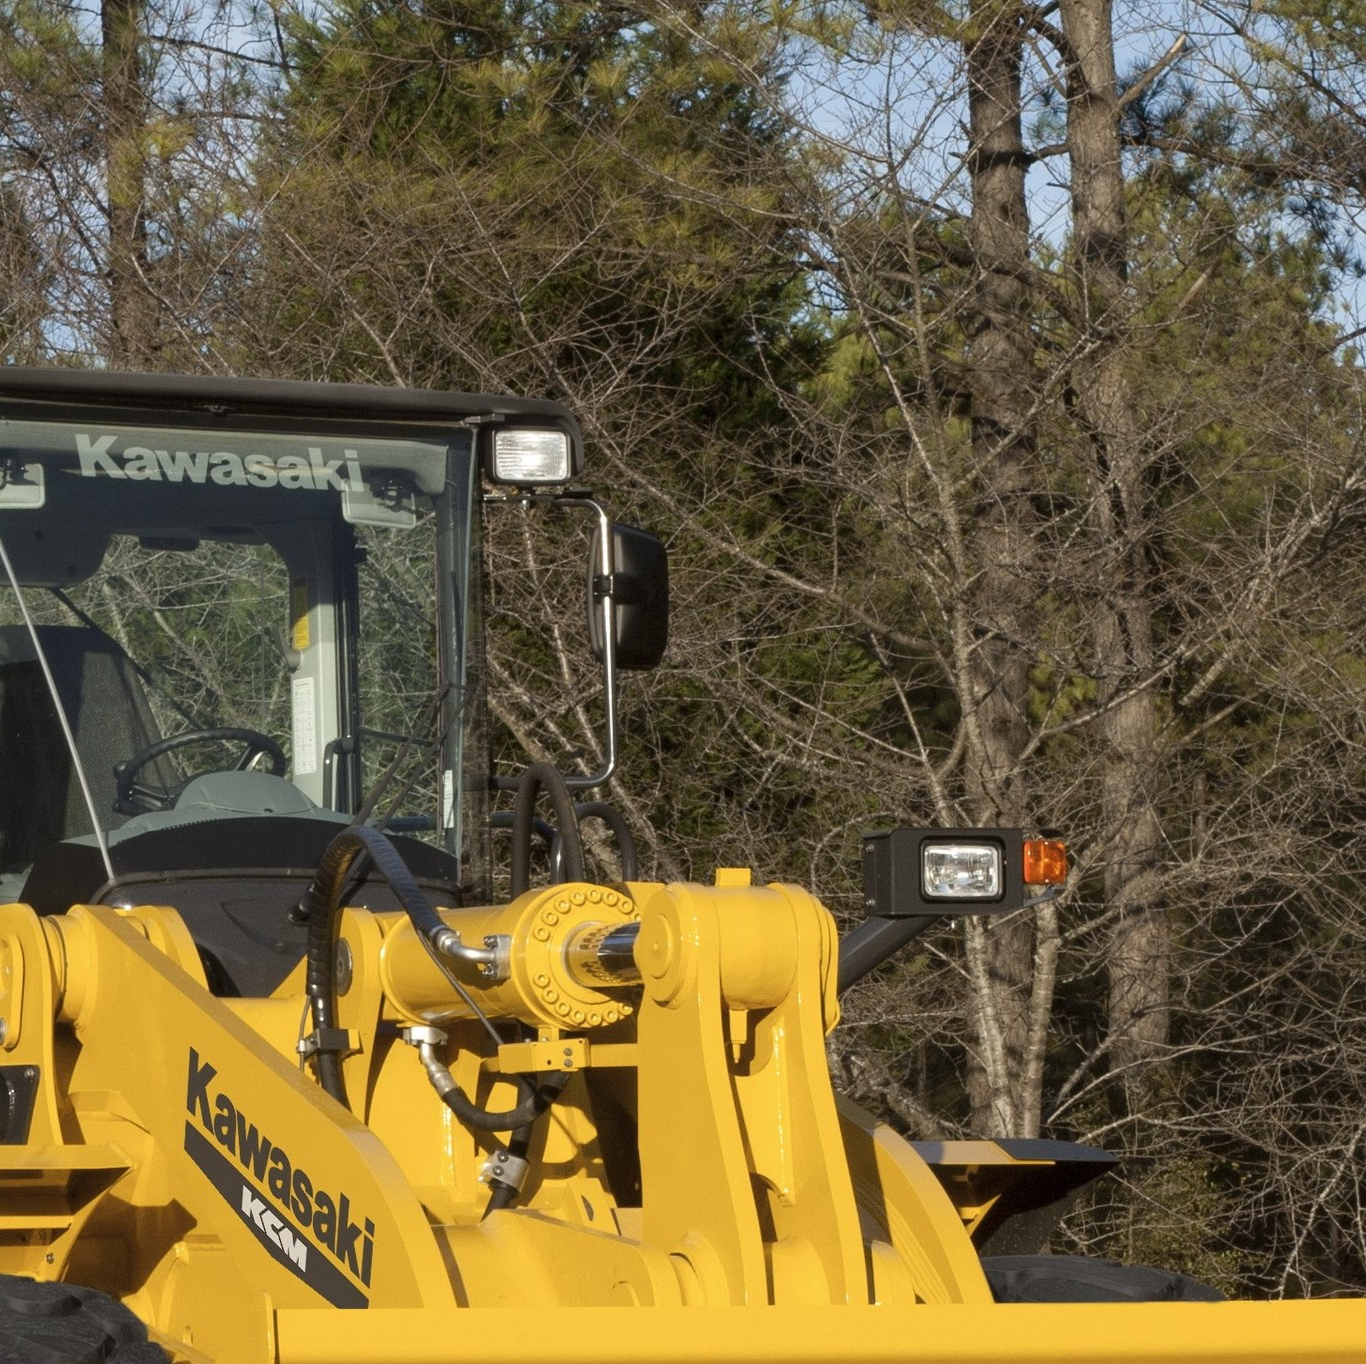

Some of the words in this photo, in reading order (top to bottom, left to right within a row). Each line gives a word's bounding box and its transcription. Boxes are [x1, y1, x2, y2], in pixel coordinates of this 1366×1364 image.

[74, 432, 365, 493] Kawasaki
[186, 1046, 375, 1289] Kawasaki
[241, 1185, 308, 1273] KCM
